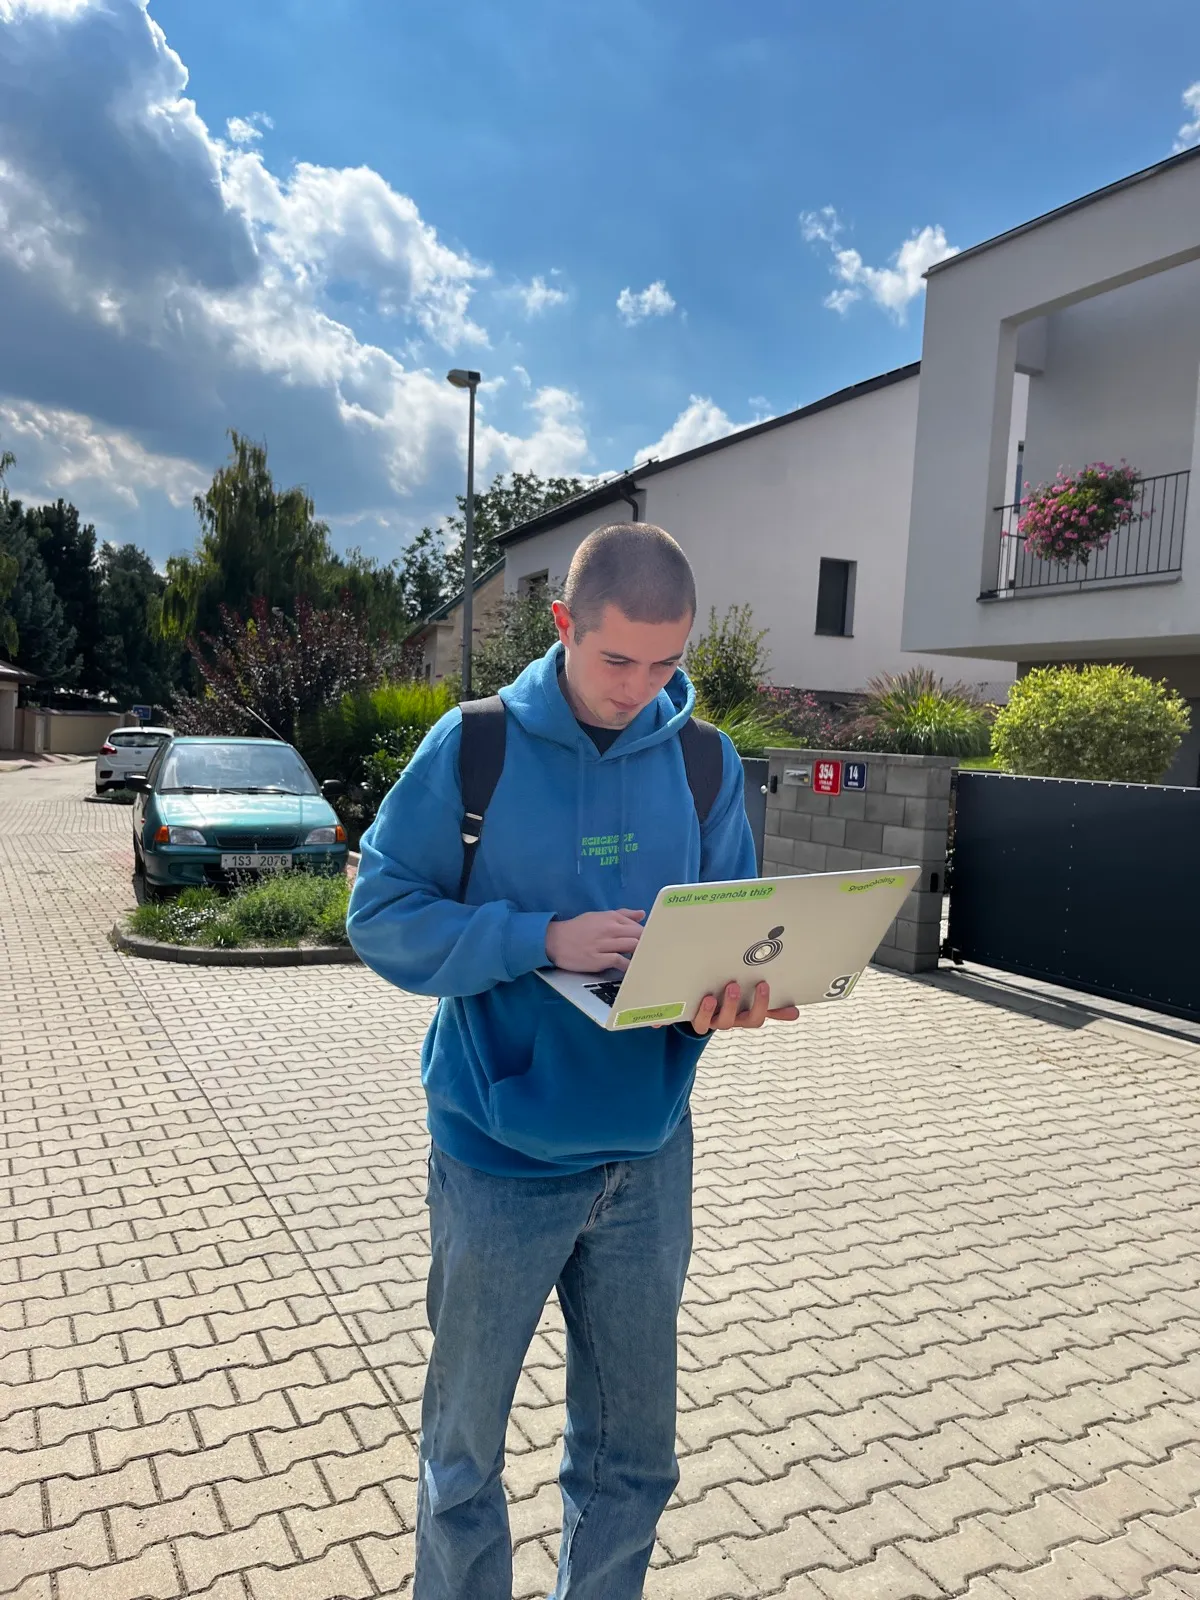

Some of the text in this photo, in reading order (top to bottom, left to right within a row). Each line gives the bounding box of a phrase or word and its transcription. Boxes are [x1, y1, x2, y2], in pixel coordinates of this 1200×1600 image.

[818, 763, 834, 780] 354
[849, 765, 859, 780] 14
[581, 834, 620, 846] ECHOES
[581, 842, 639, 856] A PREVIUS
[232, 855, 287, 867] 1S3 2076
[667, 887, 773, 904] shall we granola this?
[632, 1012, 664, 1023] granola
